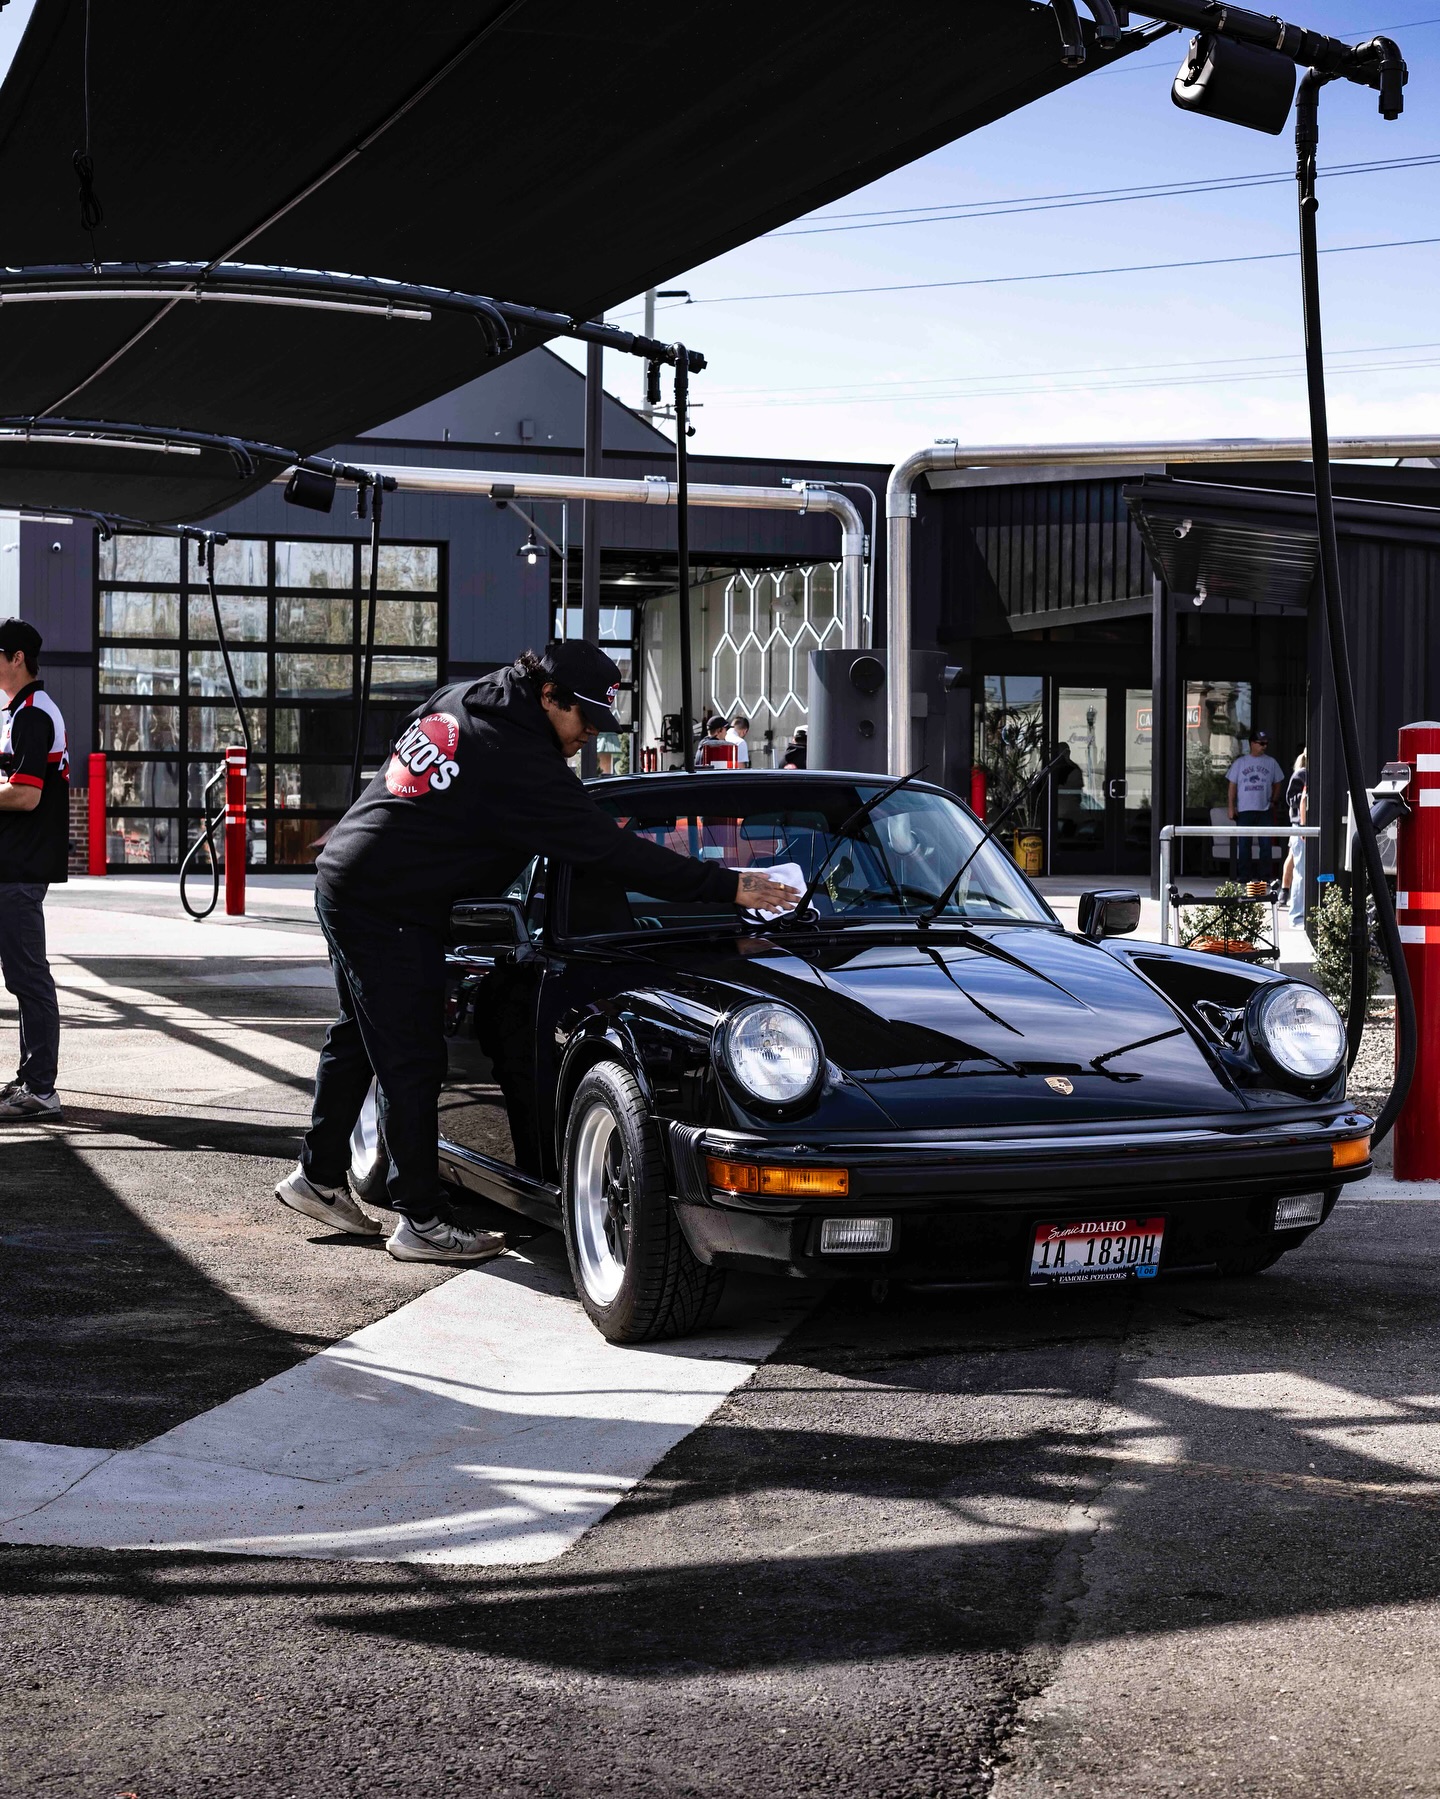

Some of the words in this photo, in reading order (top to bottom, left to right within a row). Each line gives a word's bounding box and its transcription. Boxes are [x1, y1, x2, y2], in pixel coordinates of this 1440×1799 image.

[425, 716, 448, 724] HAND
[446, 723, 455, 747] WASH
[395, 717, 460, 790] ENZO'S
[1047, 1226, 1080, 1240] Scenic
[1079, 1220, 1127, 1234] IDAHO
[1038, 1239, 1066, 1269] 1A
[1083, 1234, 1156, 1267] 183DH
[1059, 1274, 1089, 1282] FAMOUS
[1090, 1272, 1127, 1281] POTATOES
